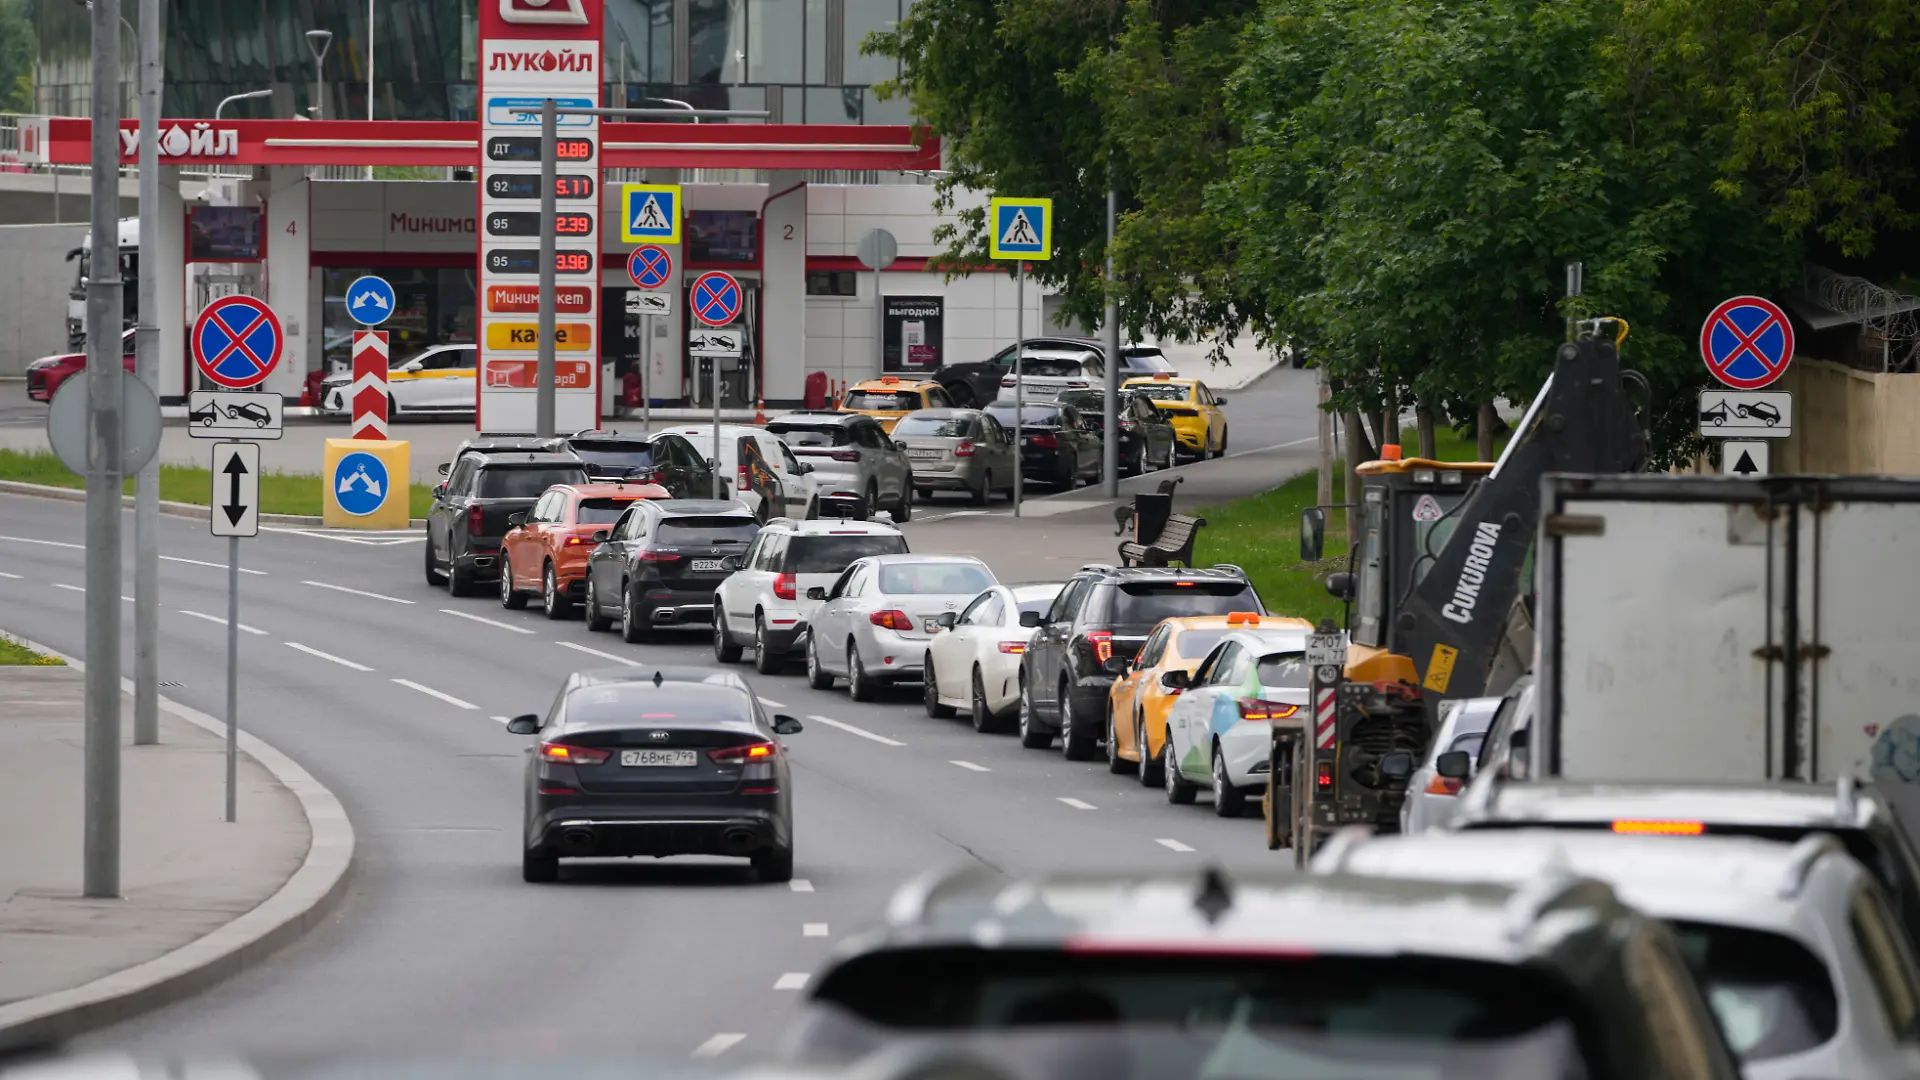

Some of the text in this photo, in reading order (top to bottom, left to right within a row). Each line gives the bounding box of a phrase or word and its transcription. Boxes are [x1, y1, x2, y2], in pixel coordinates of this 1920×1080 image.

[489, 48, 593, 72] ЛУКОЙЛ
[493, 143, 510, 155] ДТ
[493, 181, 509, 192] 92
[286, 220, 298, 236] 4
[493, 219, 508, 229] 95
[556, 217, 588, 232] 2.39
[783, 224, 795, 240] 2
[493, 256, 508, 267] 95
[556, 255, 588, 270] 3.98
[495, 290, 584, 305] Минимкет
[511, 329, 567, 343] кае
[1320, 668, 1335, 679] 40
